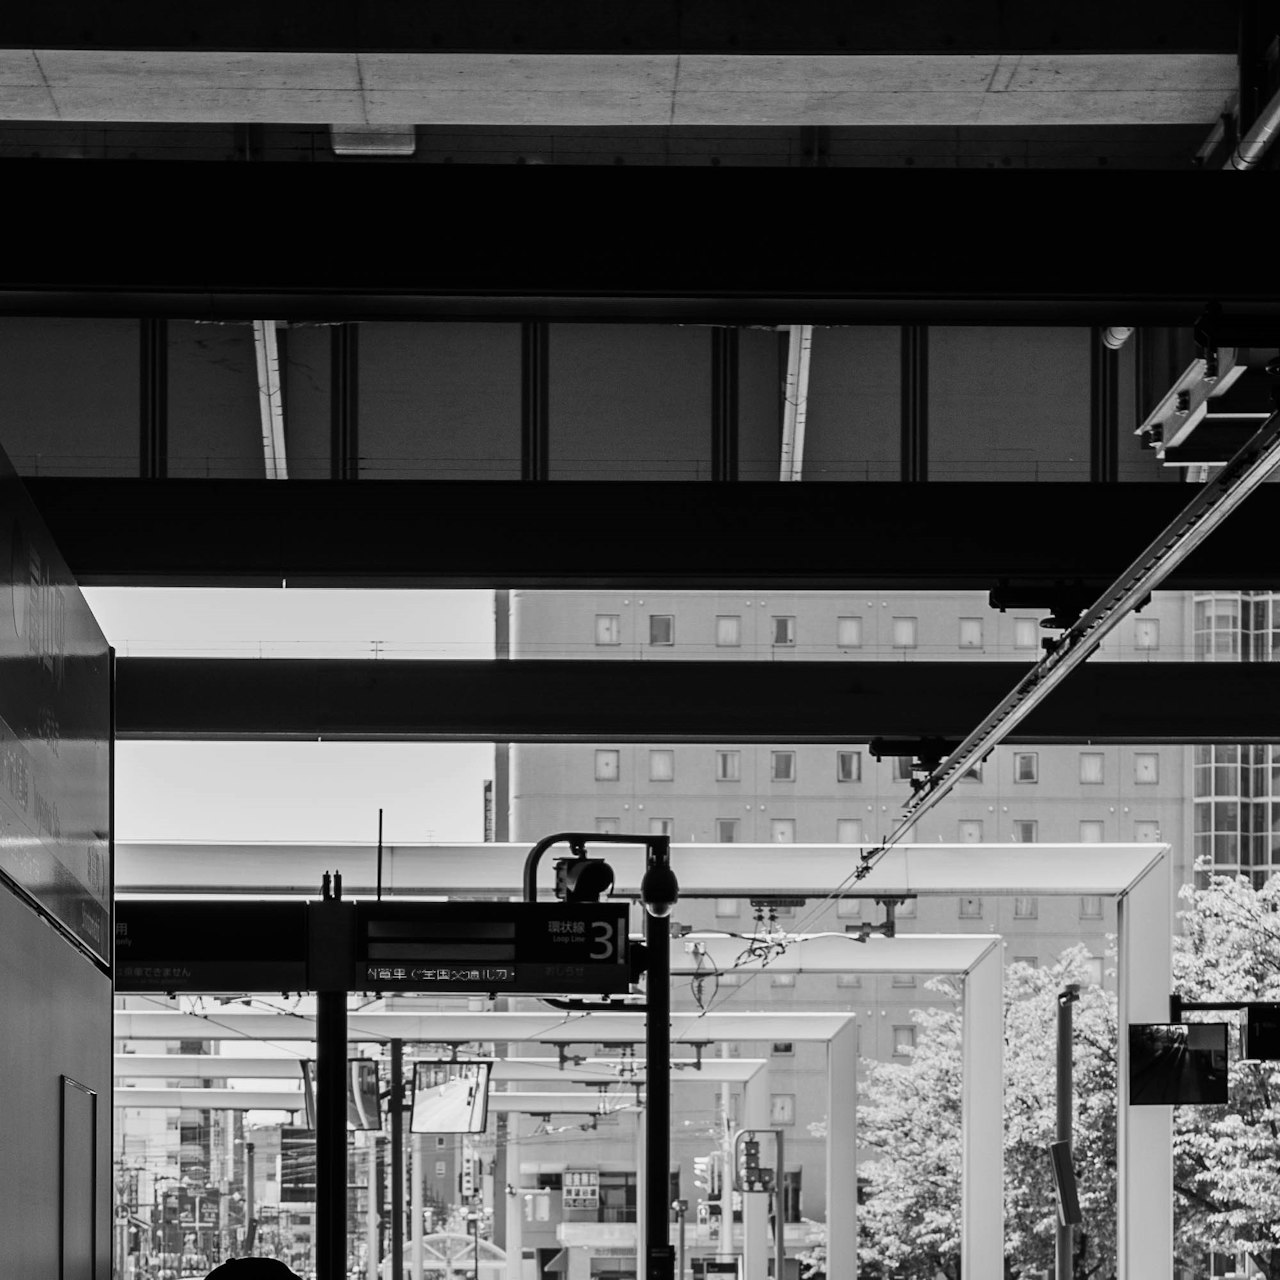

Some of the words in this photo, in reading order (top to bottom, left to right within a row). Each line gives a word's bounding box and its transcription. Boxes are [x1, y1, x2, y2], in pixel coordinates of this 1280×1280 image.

[548, 920, 585, 934] 環状線
[589, 921, 613, 960] 3
